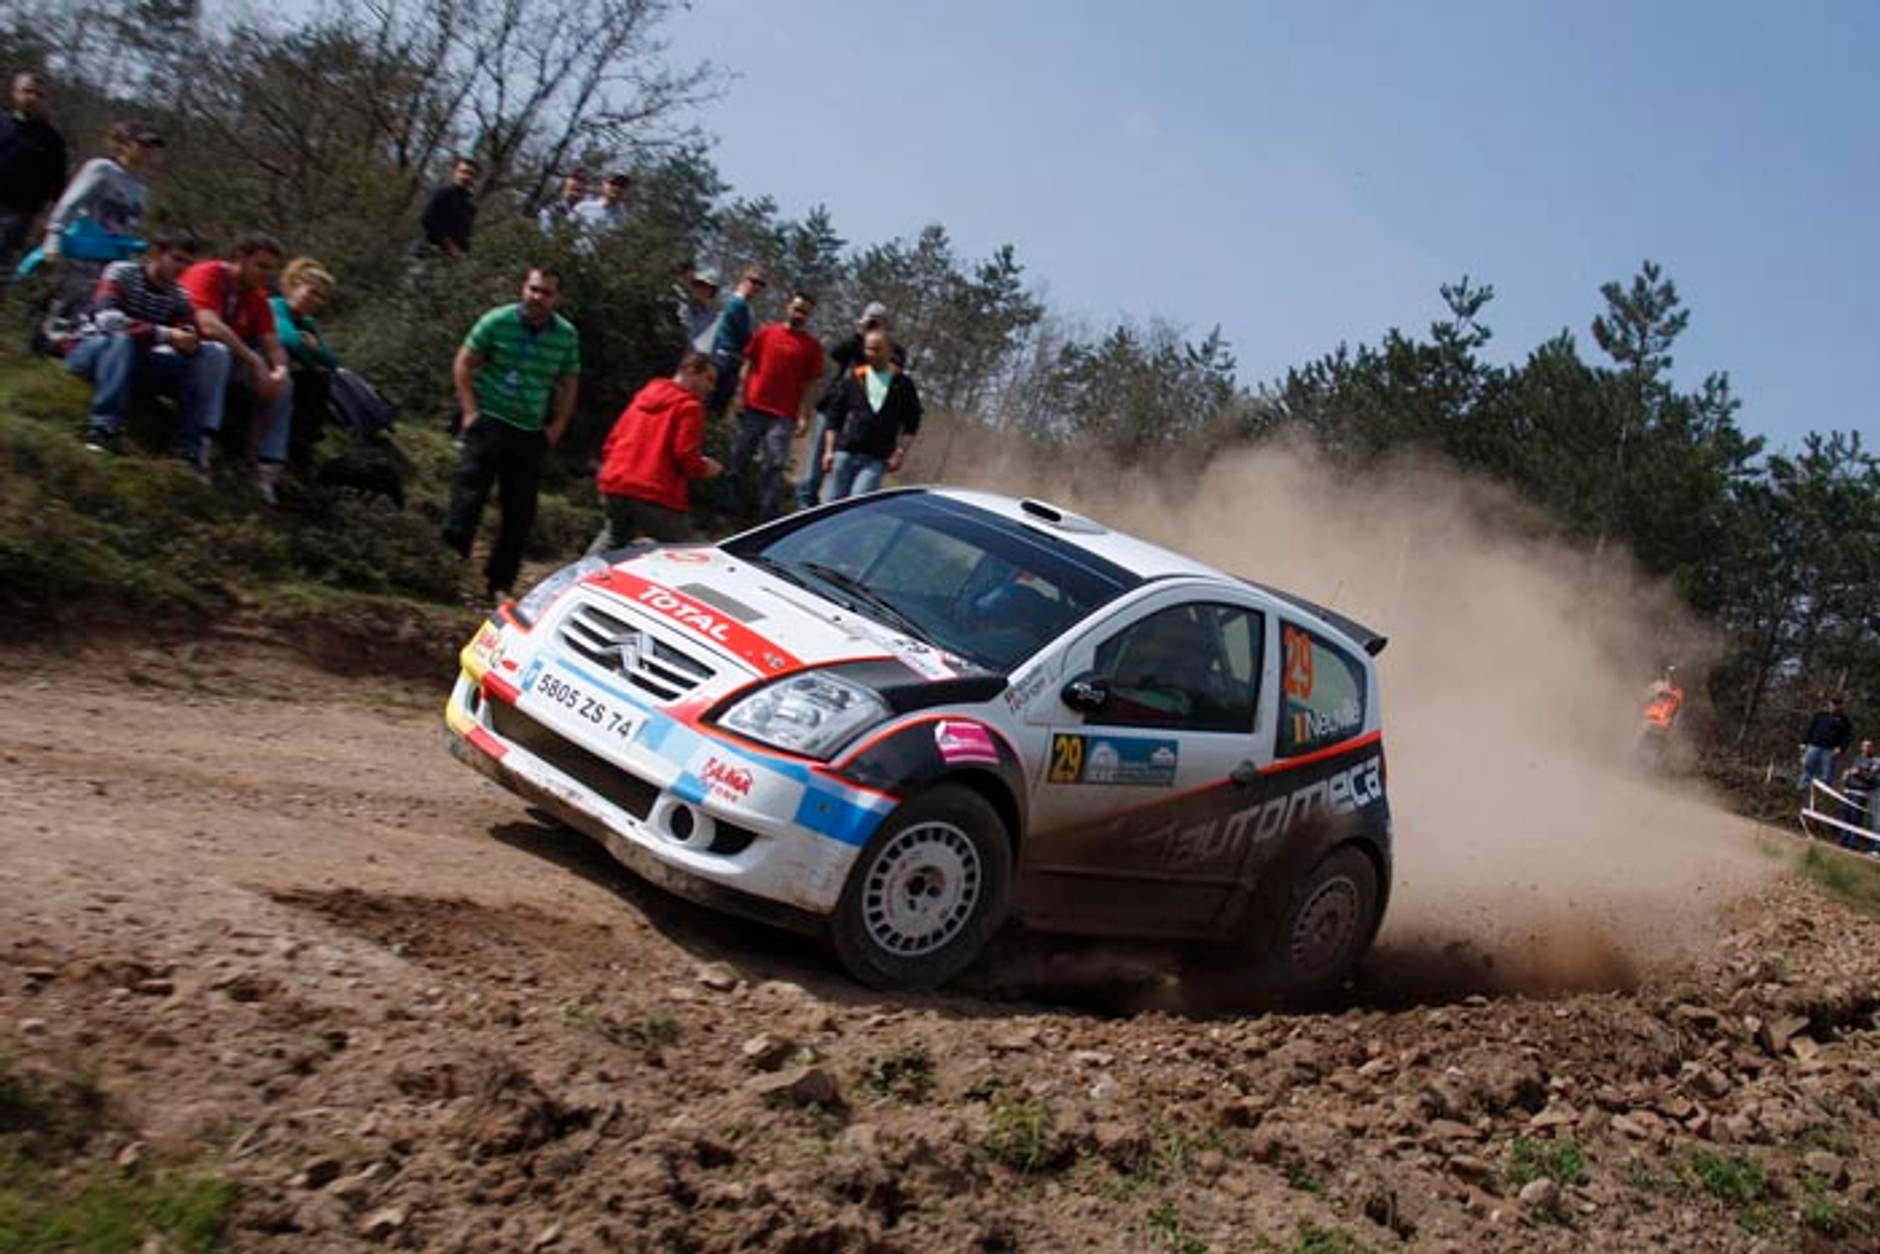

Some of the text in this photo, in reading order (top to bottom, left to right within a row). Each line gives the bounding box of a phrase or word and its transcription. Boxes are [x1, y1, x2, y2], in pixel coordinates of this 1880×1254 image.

[639, 585, 729, 640] TOTAL
[1283, 624, 1313, 700] 29
[537, 673, 632, 736] 5805 ZS 74
[1052, 735, 1082, 783] 29
